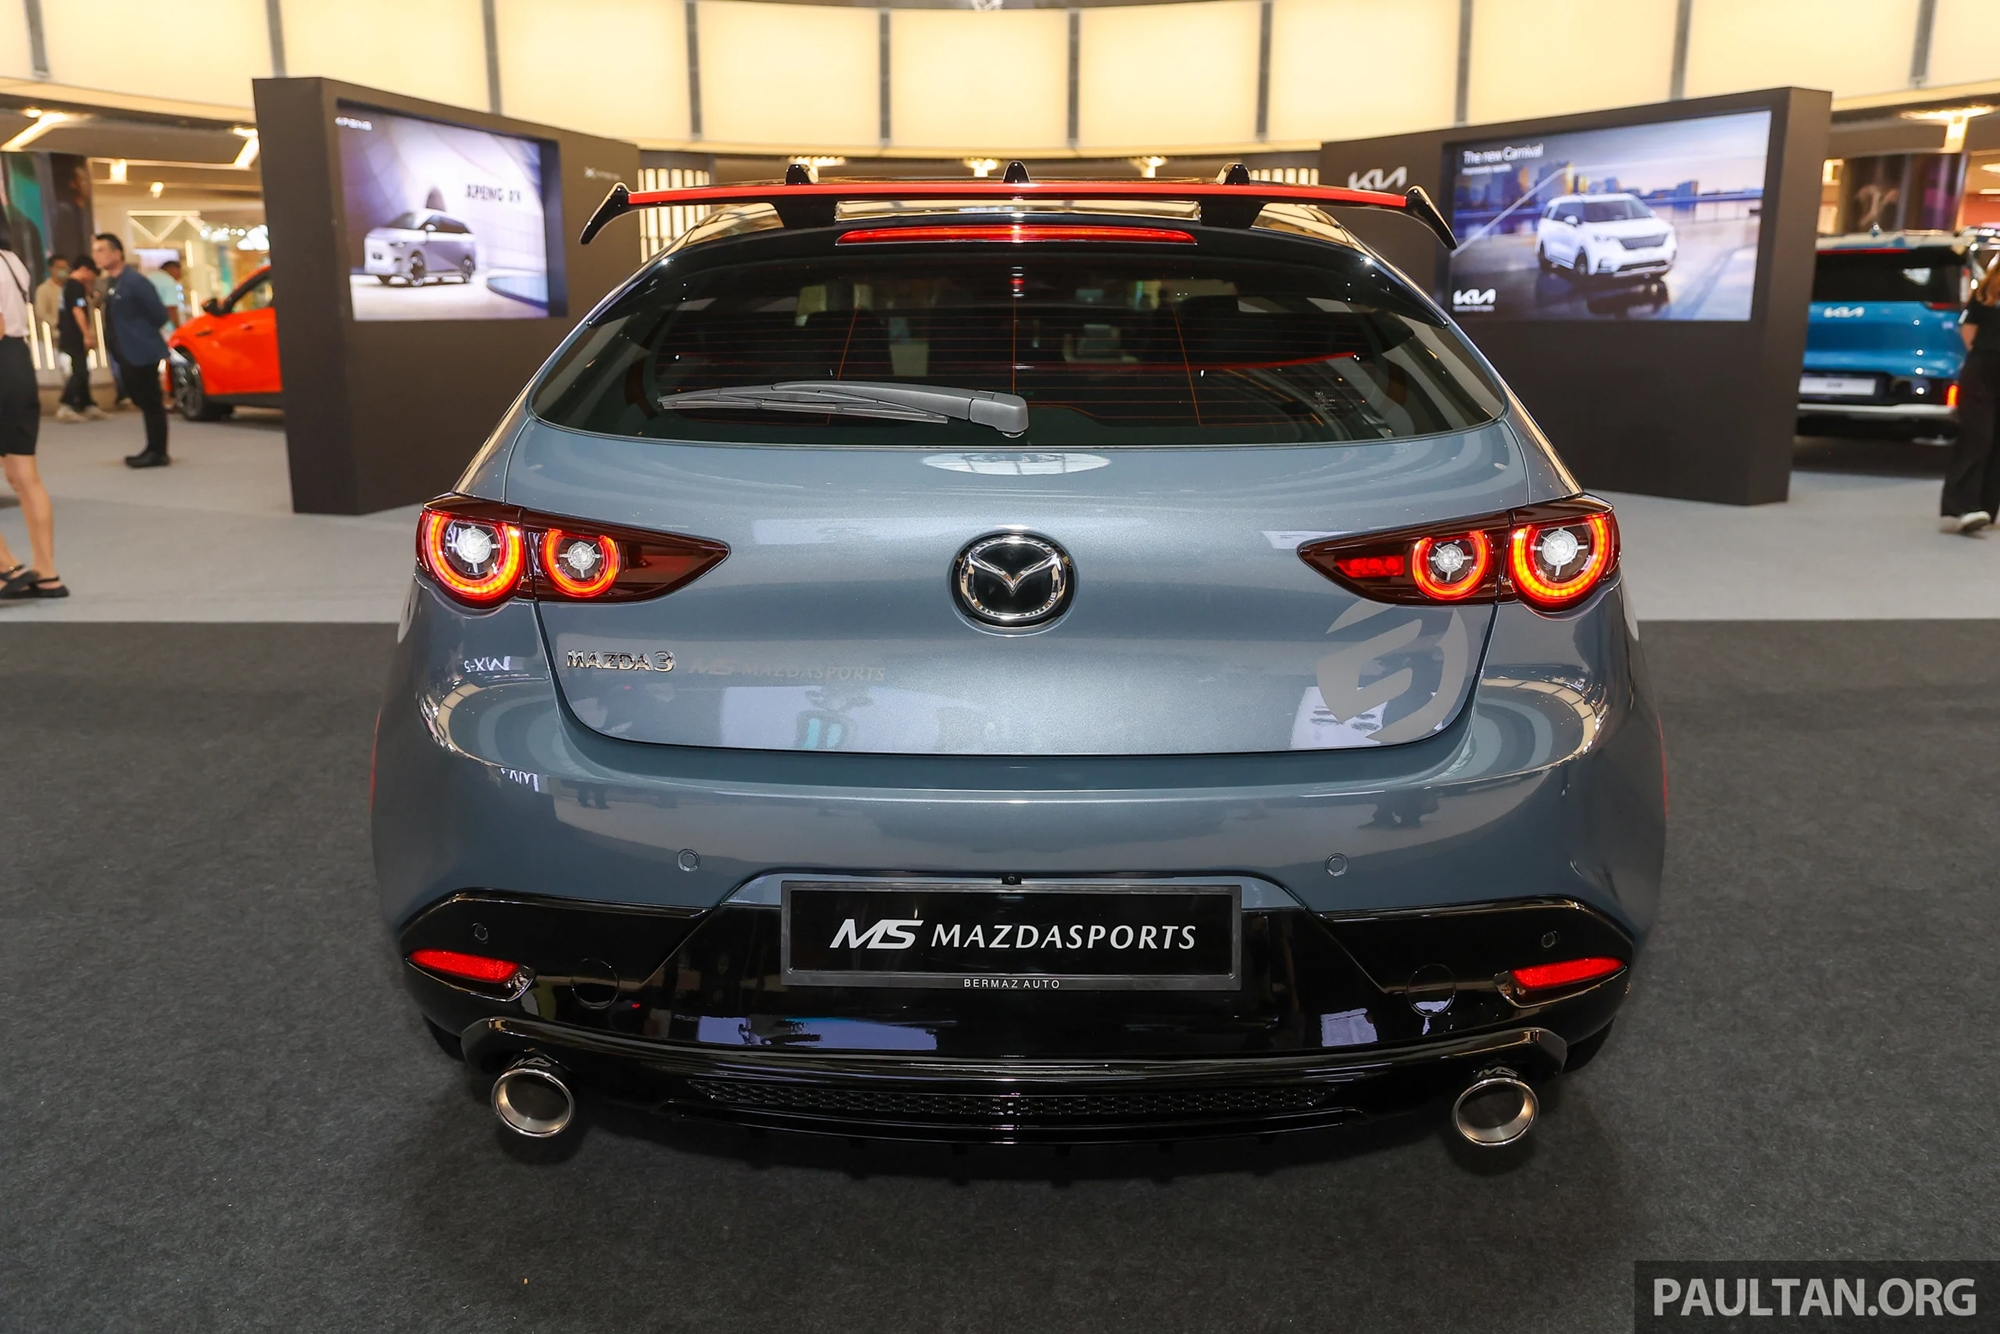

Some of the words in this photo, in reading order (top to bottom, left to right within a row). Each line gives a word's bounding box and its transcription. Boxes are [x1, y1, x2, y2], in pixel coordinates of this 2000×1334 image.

[742, 662, 886, 682] MAZDASPORTS
[829, 918, 925, 950] MS
[930, 923, 1196, 950] MAZDASPORTS
[963, 978, 1018, 989] BERMAZ
[1023, 979, 1061, 989] AUTO
